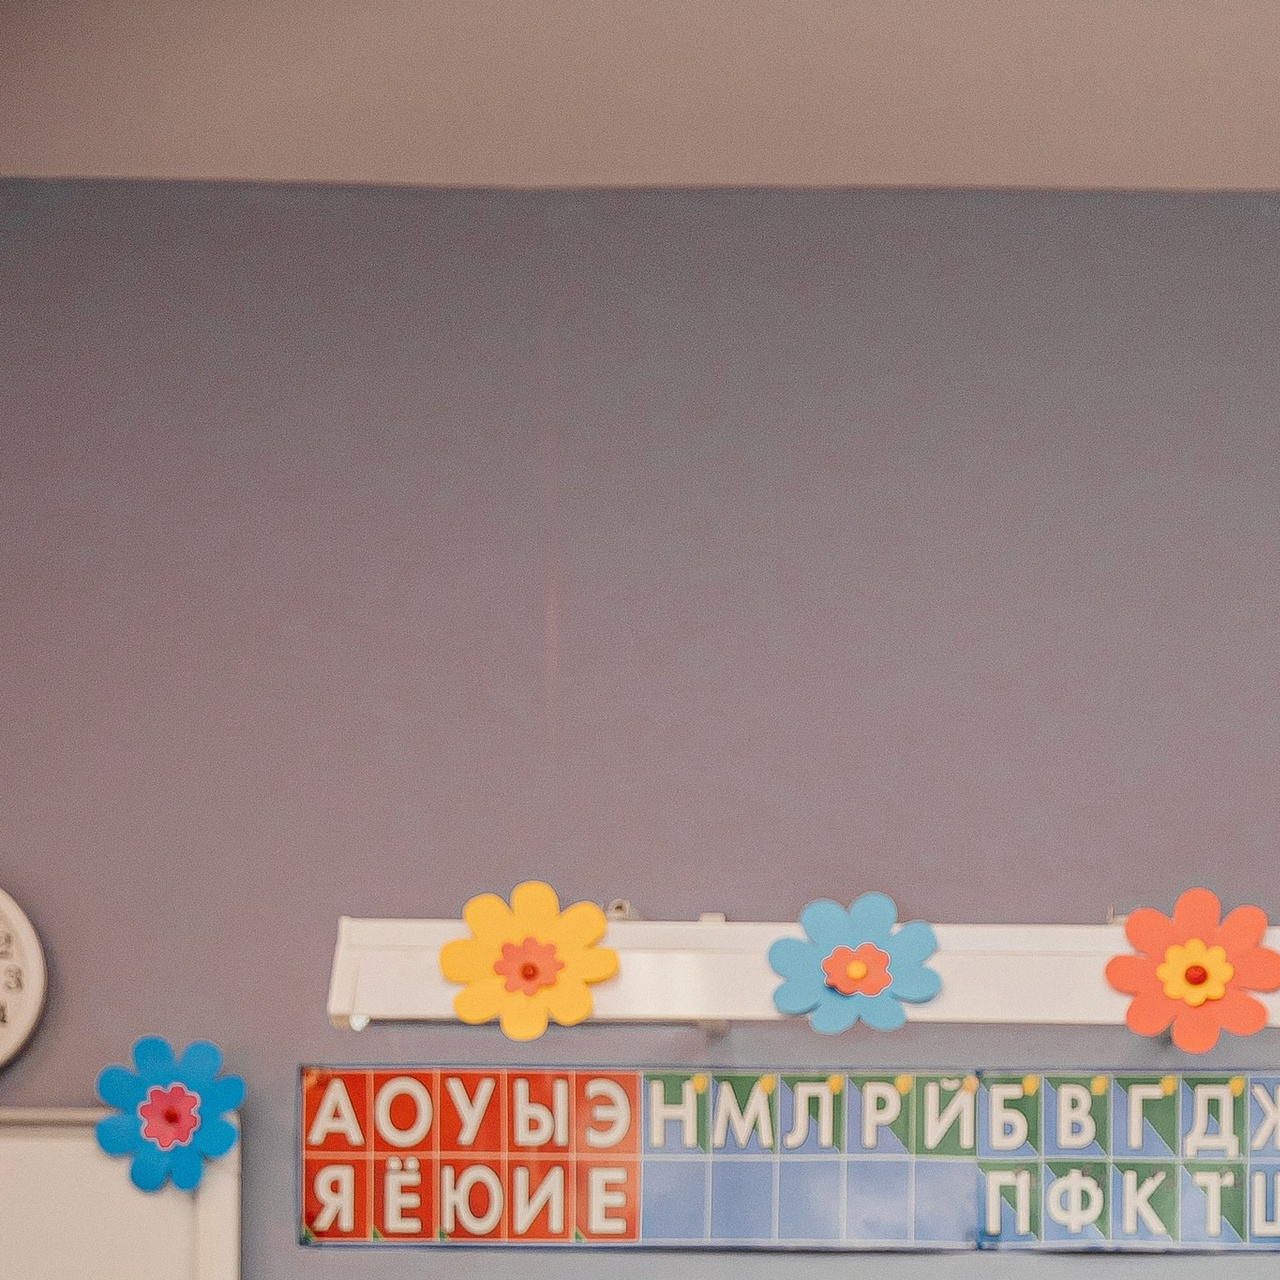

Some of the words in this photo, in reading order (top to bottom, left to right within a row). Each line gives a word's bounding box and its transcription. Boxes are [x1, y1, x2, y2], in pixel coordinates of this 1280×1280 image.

[307, 1077, 365, 1146] А
[374, 1076, 433, 1147] О
[445, 1076, 495, 1146] У
[513, 1077, 569, 1147] Ы
[585, 1077, 631, 1148] Э
[649, 1080, 698, 1148] Н
[712, 1080, 774, 1148] М
[783, 1082, 833, 1148] Л
[862, 1081, 901, 1148] Р
[923, 1077, 974, 1149] Й
[990, 1083, 1028, 1149] Б
[1057, 1083, 1096, 1149] В
[1127, 1083, 1168, 1149] Г
[1184, 1083, 1239, 1158] Д
[311, 1164, 354, 1232] Я
[384, 1156, 422, 1233] Ё
[441, 1164, 504, 1235] Ю
[512, 1165, 564, 1234] И
[587, 1166, 628, 1233] Е
[984, 1170, 1031, 1235] П
[1046, 1169, 1104, 1234] Ф
[1122, 1169, 1167, 1235] К
[1193, 1169, 1235, 1237] Т
